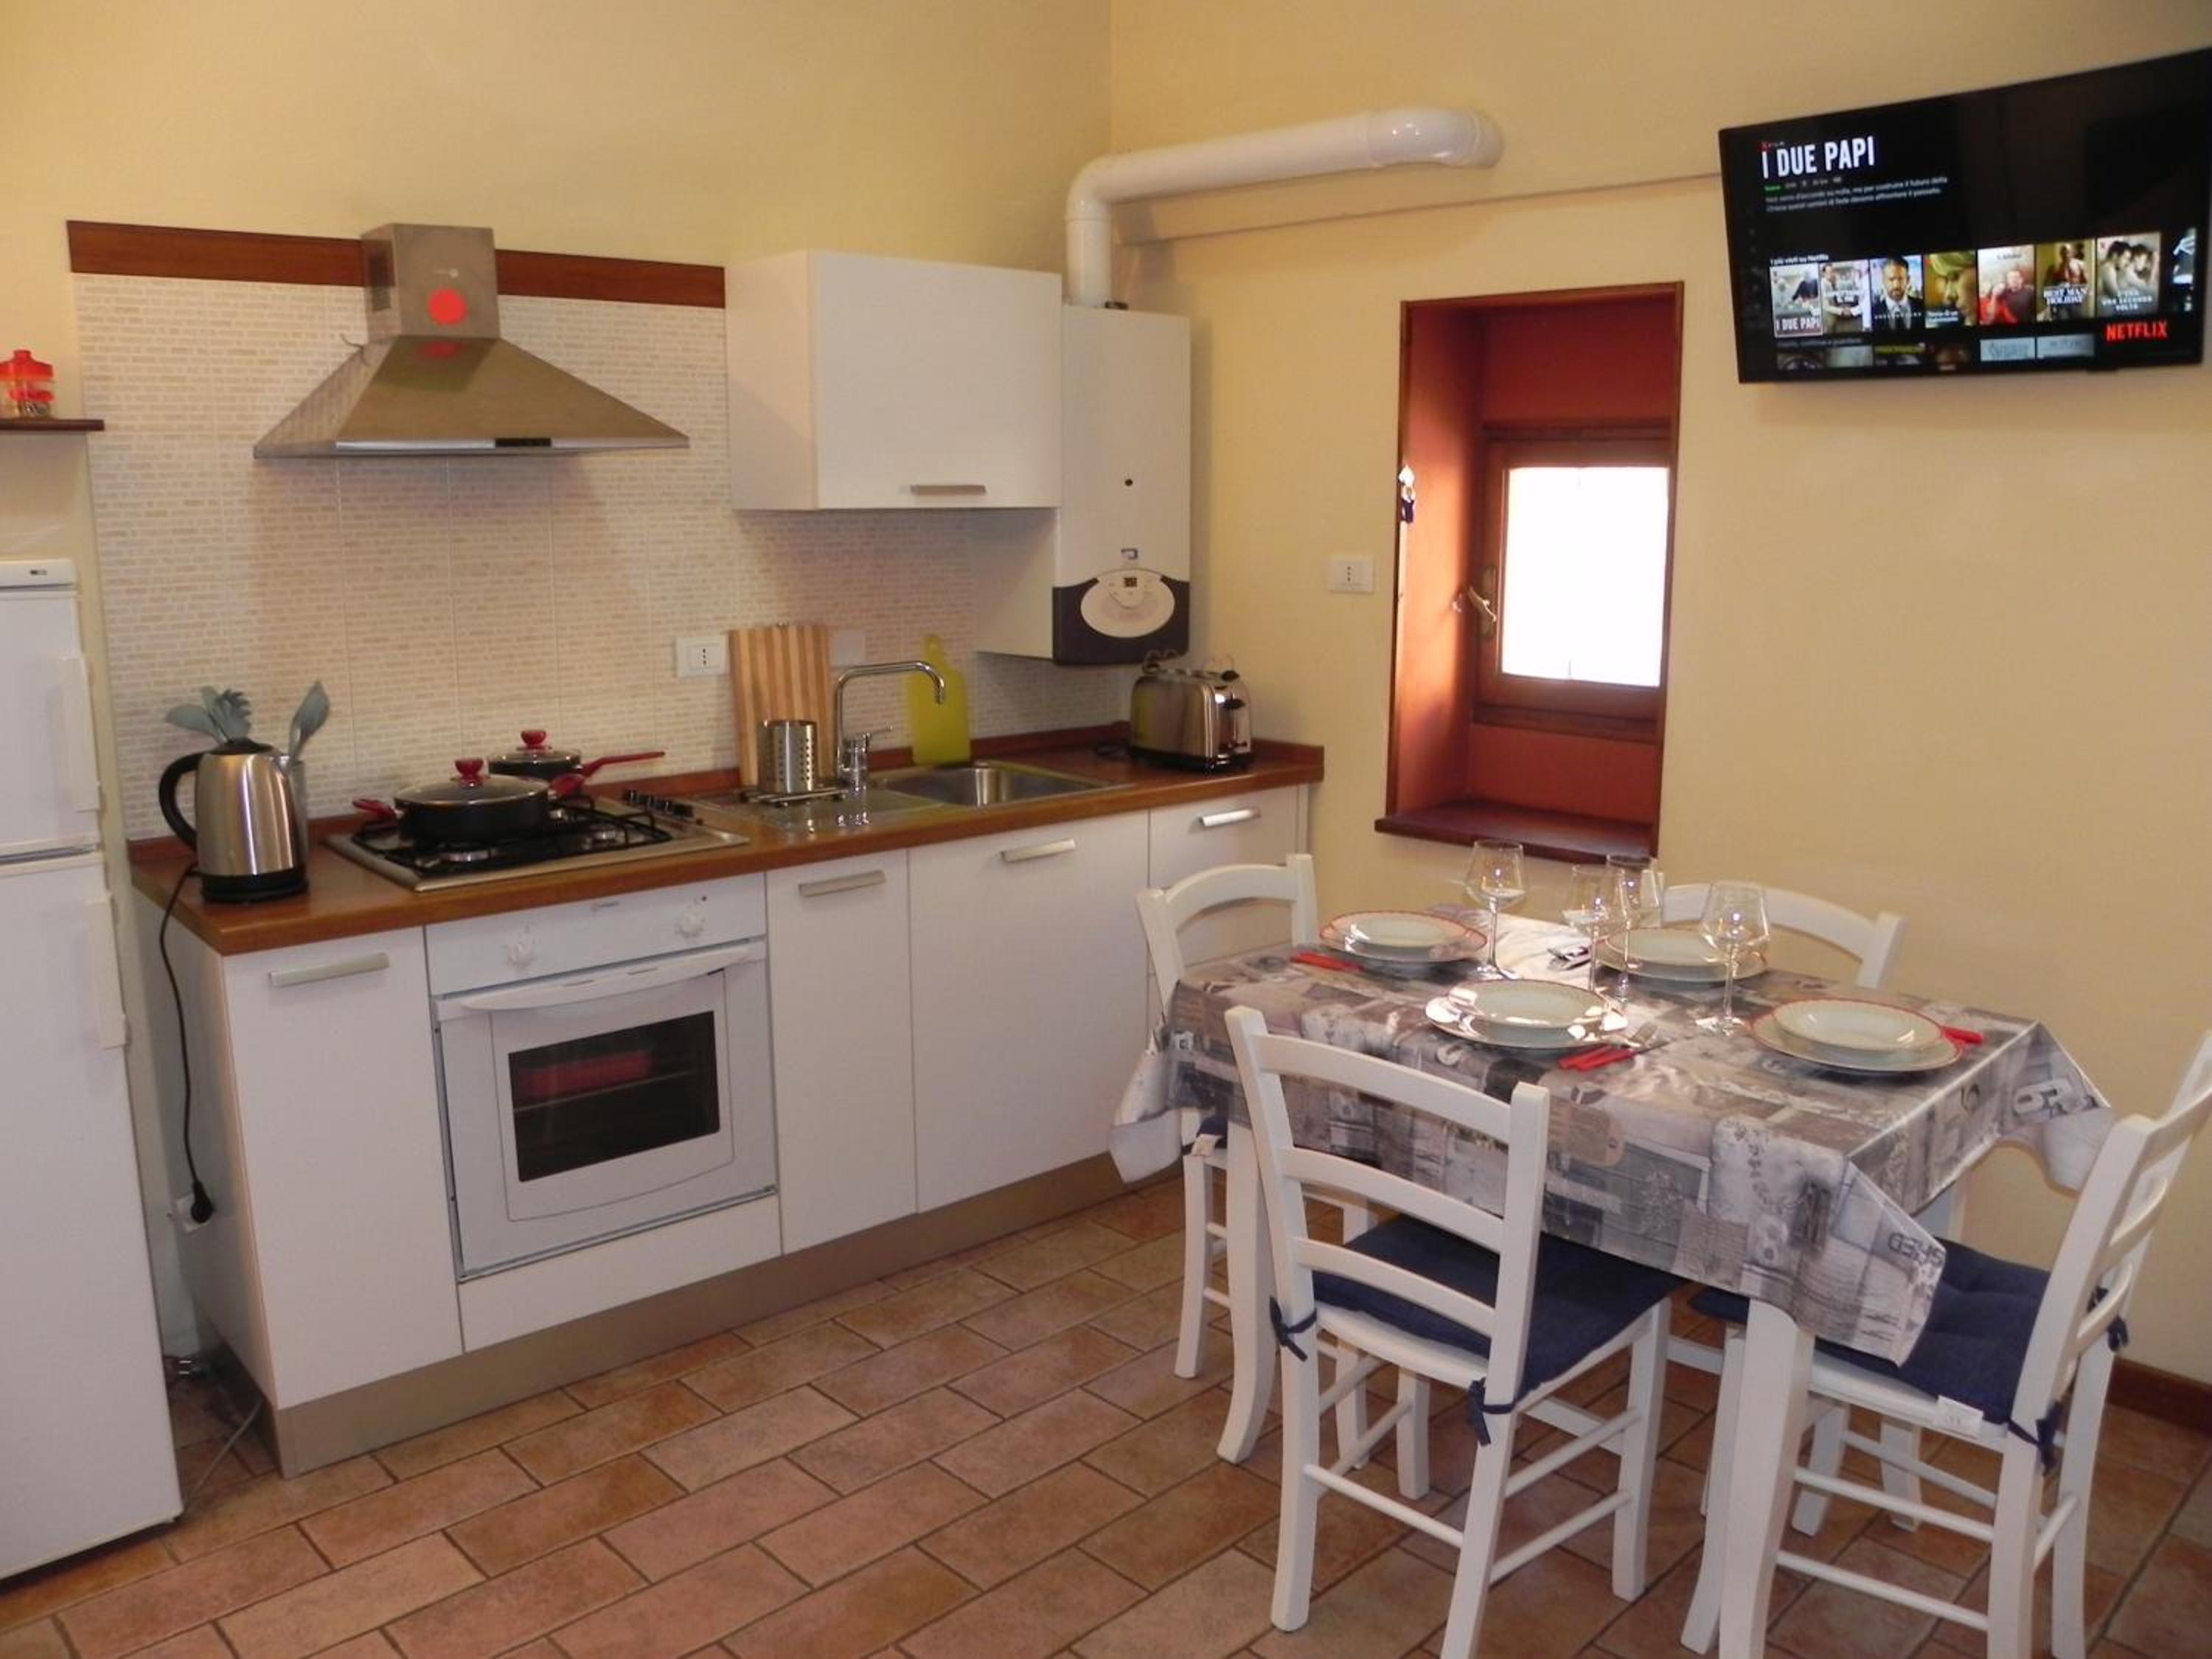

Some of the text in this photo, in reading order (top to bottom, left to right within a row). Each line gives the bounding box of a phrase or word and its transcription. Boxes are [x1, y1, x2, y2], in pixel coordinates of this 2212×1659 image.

[1761, 136, 1875, 179] I DUE PAPI
[2065, 287, 2089, 296] MAN
[2045, 296, 2084, 305] HOLIDAY
[1781, 318, 1800, 331] DUE
[1800, 316, 1820, 330] PAPI
[2105, 320, 2168, 341] NETFLIX
